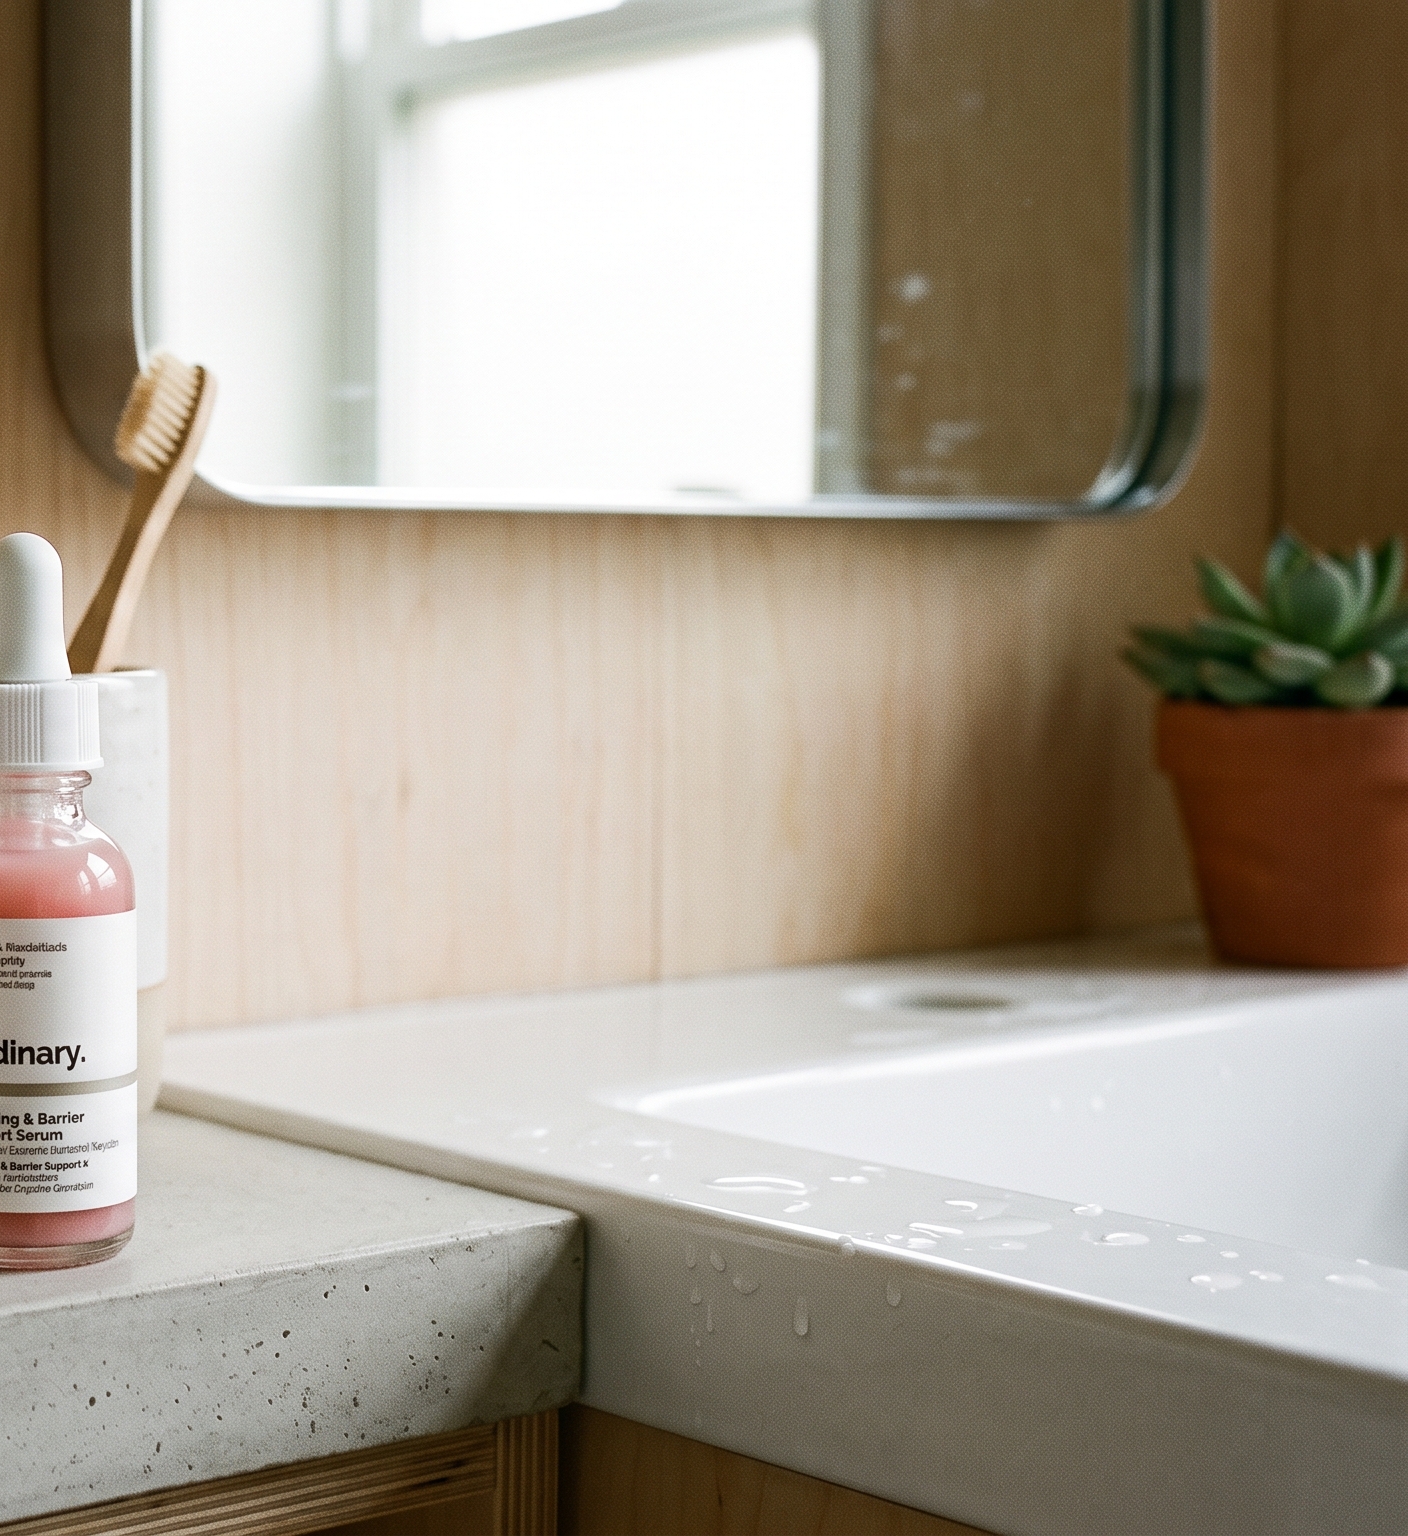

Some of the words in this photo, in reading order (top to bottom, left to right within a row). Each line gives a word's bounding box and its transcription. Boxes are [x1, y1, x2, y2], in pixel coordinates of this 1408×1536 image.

[23, 1113, 34, 1125] &
[37, 1111, 85, 1125] Barrier
[16, 1129, 63, 1141] Serum
[0, 1161, 8, 1171] &
[9, 1161, 43, 1171] Barrier
[44, 1159, 81, 1172] Support
